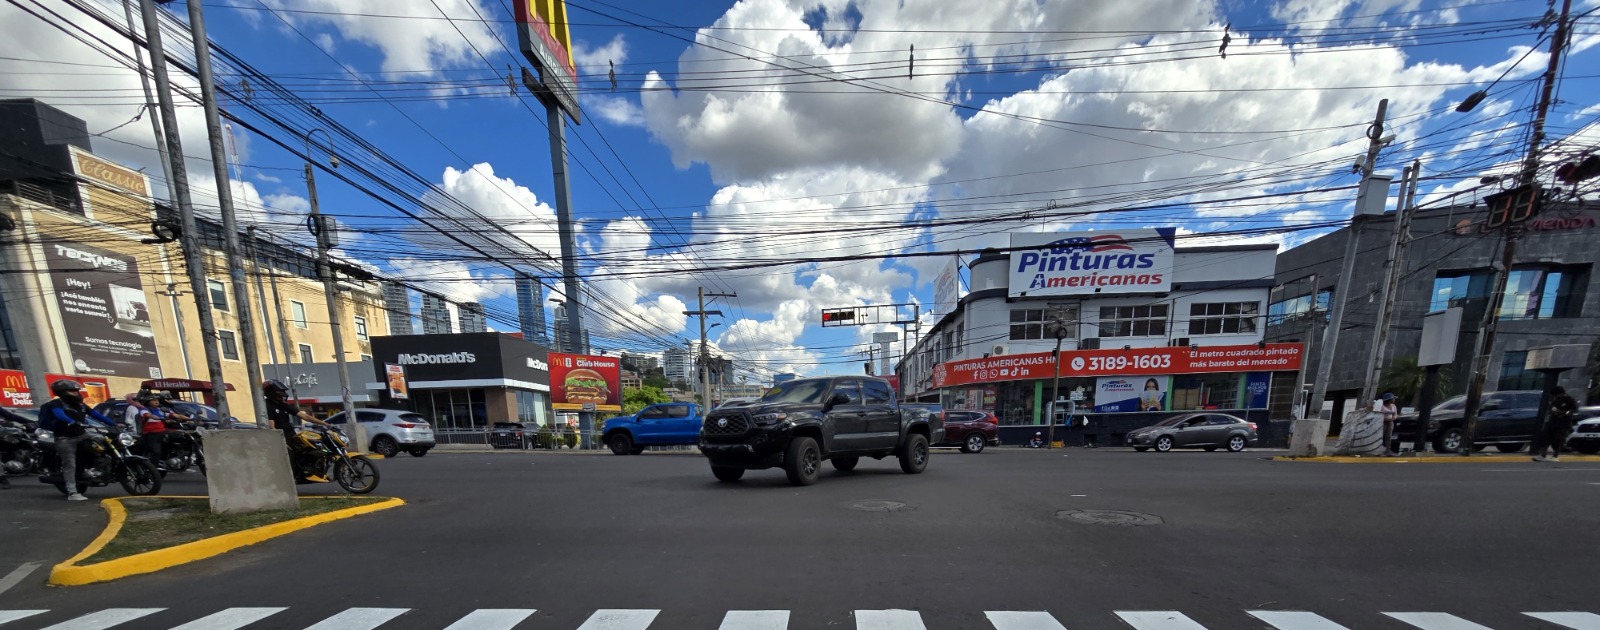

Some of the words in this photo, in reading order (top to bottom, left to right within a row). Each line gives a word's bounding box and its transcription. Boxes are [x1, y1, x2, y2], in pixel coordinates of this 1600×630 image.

[79, 158, 144, 191] Classic
[1018, 251, 1155, 272] Pinturas
[66, 278, 91, 289] ¡Hey!
[1029, 272, 1163, 288] Americanas
[85, 336, 108, 345] Somos
[398, 352, 476, 365] McDonald's
[1226, 348, 1264, 357] cuadrado
[1266, 347, 1298, 356] pintado
[526, 357, 549, 371] McDon
[953, 361, 985, 372] PINTURAS
[988, 357, 1043, 369] AMERICANAS
[1088, 354, 1171, 371] 3189-1603
[1190, 360, 1207, 368] más
[1209, 359, 1235, 367] barato
[4, 390, 31, 399] Desay
